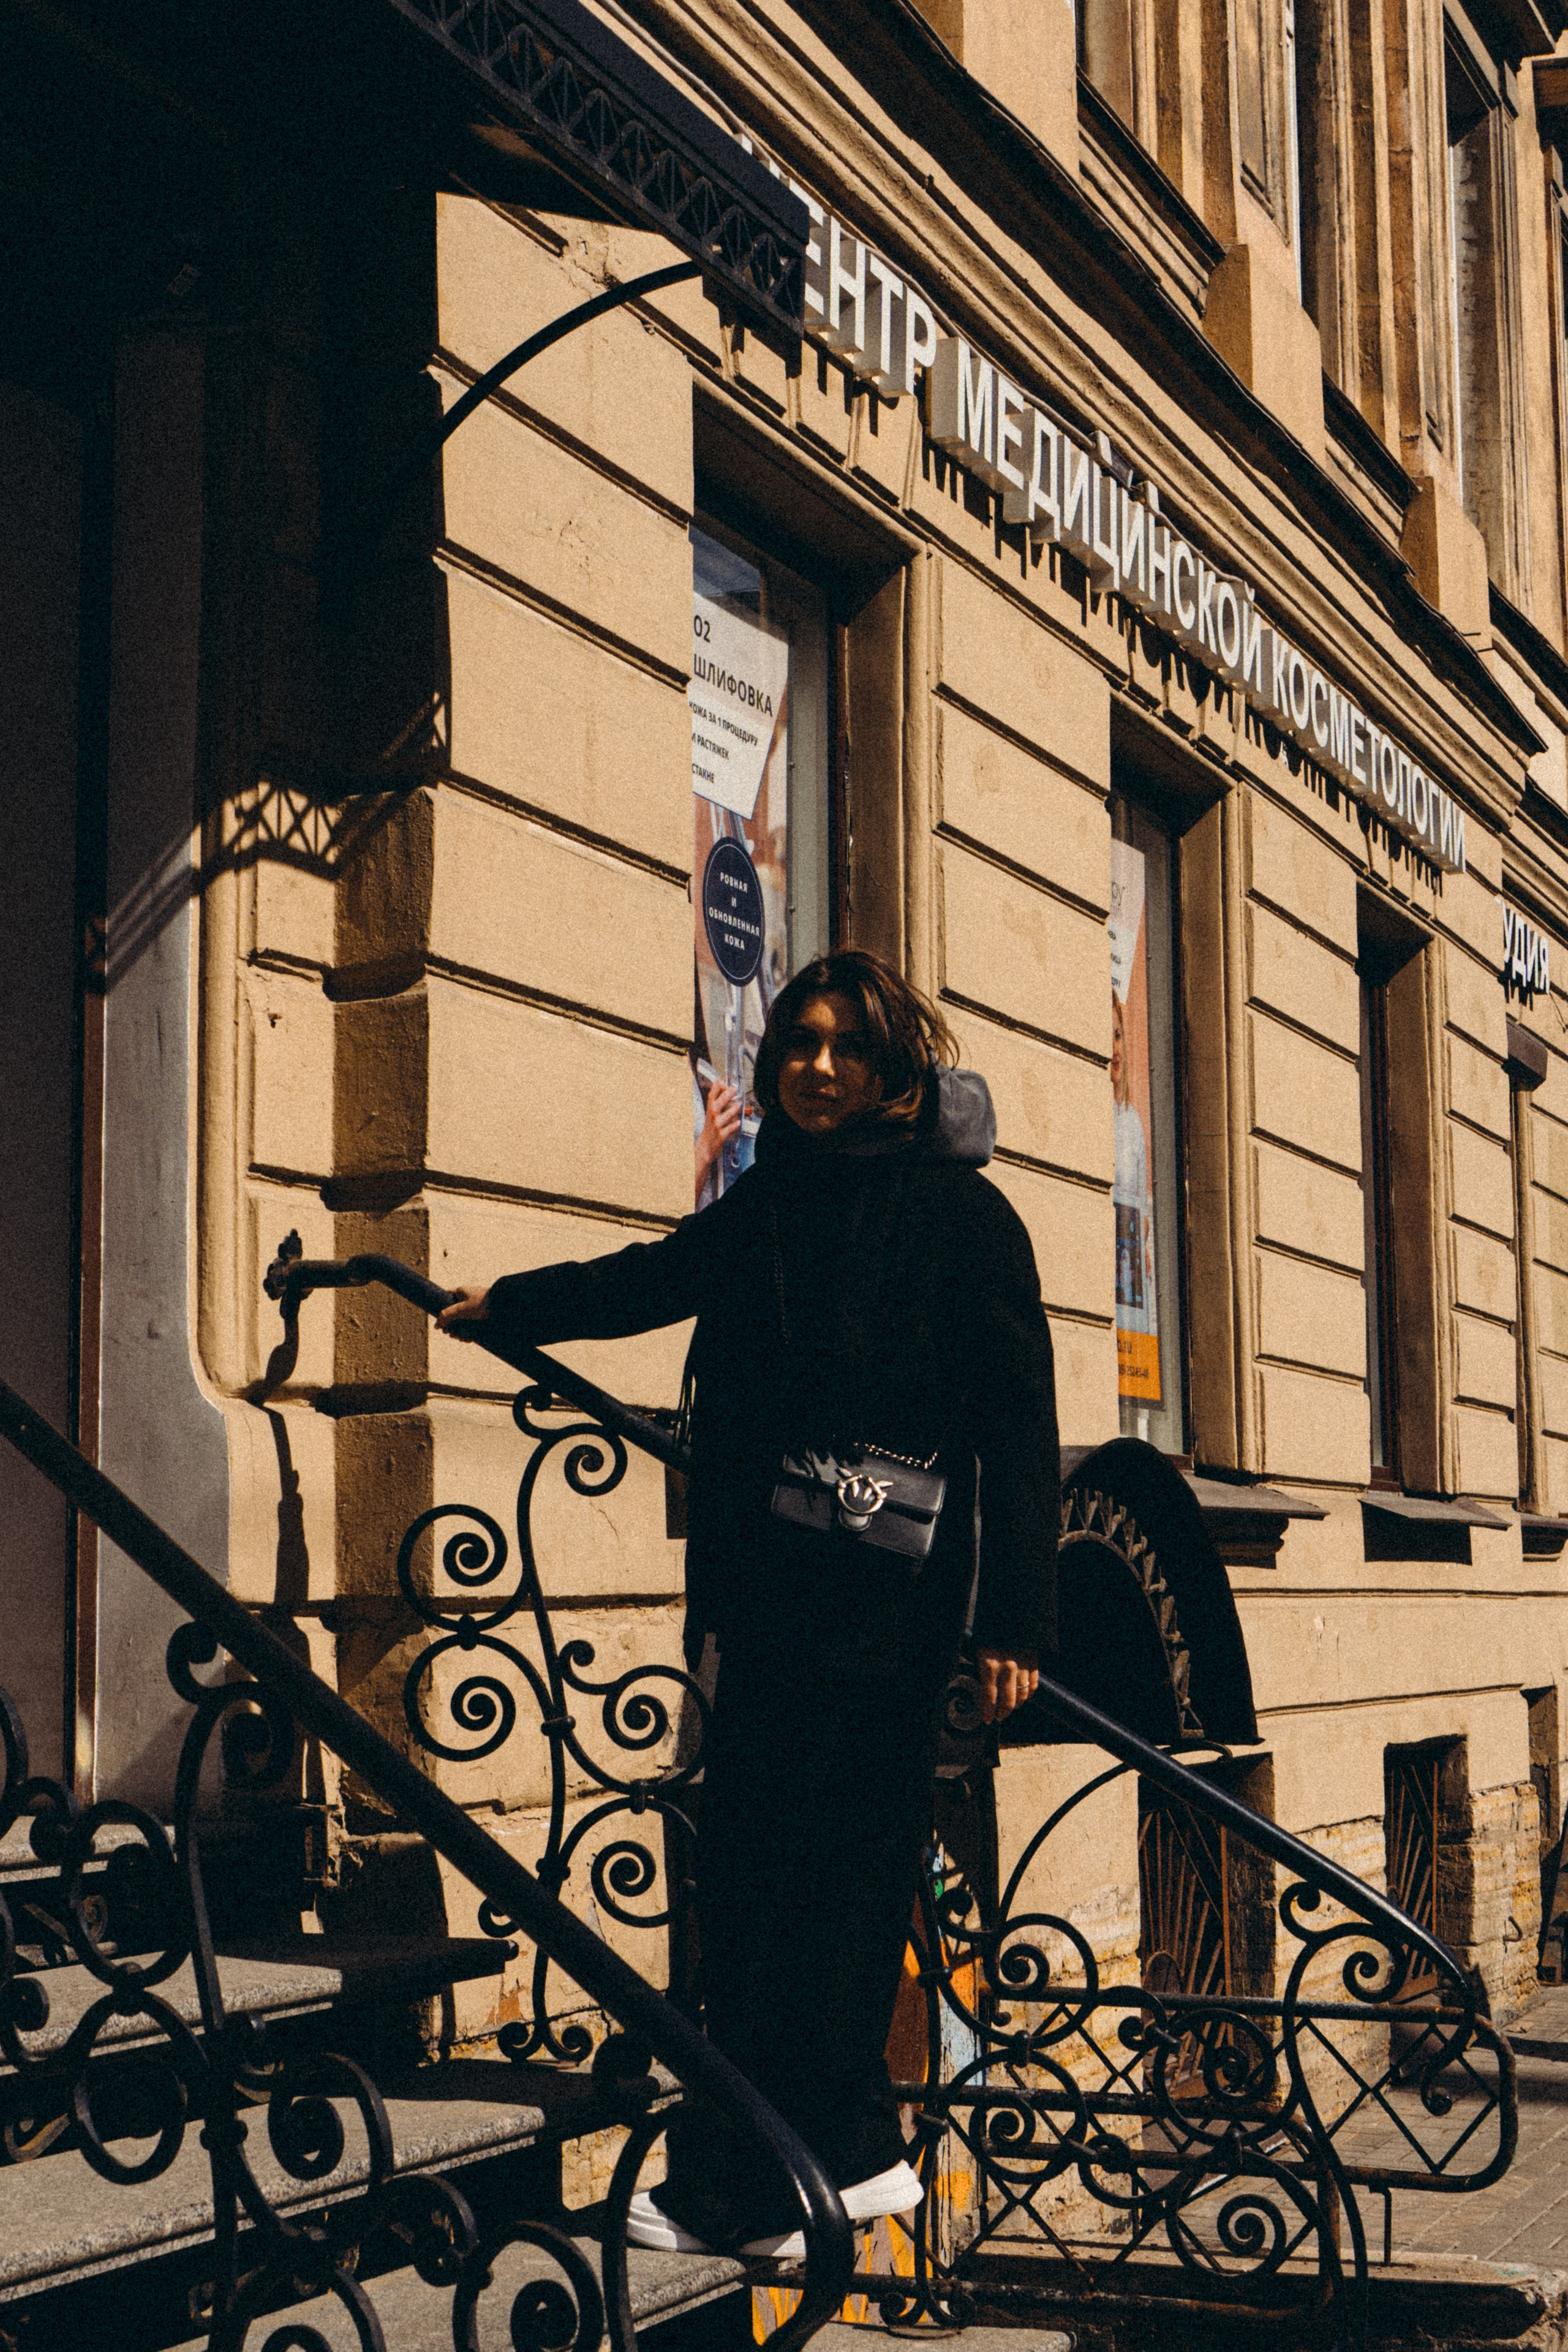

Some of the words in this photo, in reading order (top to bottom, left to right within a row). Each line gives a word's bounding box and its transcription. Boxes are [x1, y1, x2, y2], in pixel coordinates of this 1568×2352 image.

[742, 134, 937, 396] ЕНТР
[958, 337, 1262, 693] МЕДИЦИНСКОЙ
[1272, 628, 1466, 873] КОСМЕТОЛОГИИ
[693, 653, 773, 717] ШЛИФОВКА
[709, 712, 717, 725] ЗА
[718, 717, 722, 727] 1
[722, 719, 758, 746] ПРОЦЕДУРУ
[697, 734, 729, 760] РАСТЯЖЕК
[720, 872, 747, 893] РОВНАЯ
[731, 897, 737, 908] И
[709, 907, 760, 937] ОБНОВЛЕННАЯ
[724, 933, 745, 951] КОЖА
[1494, 895, 1550, 995] УДИЯ
